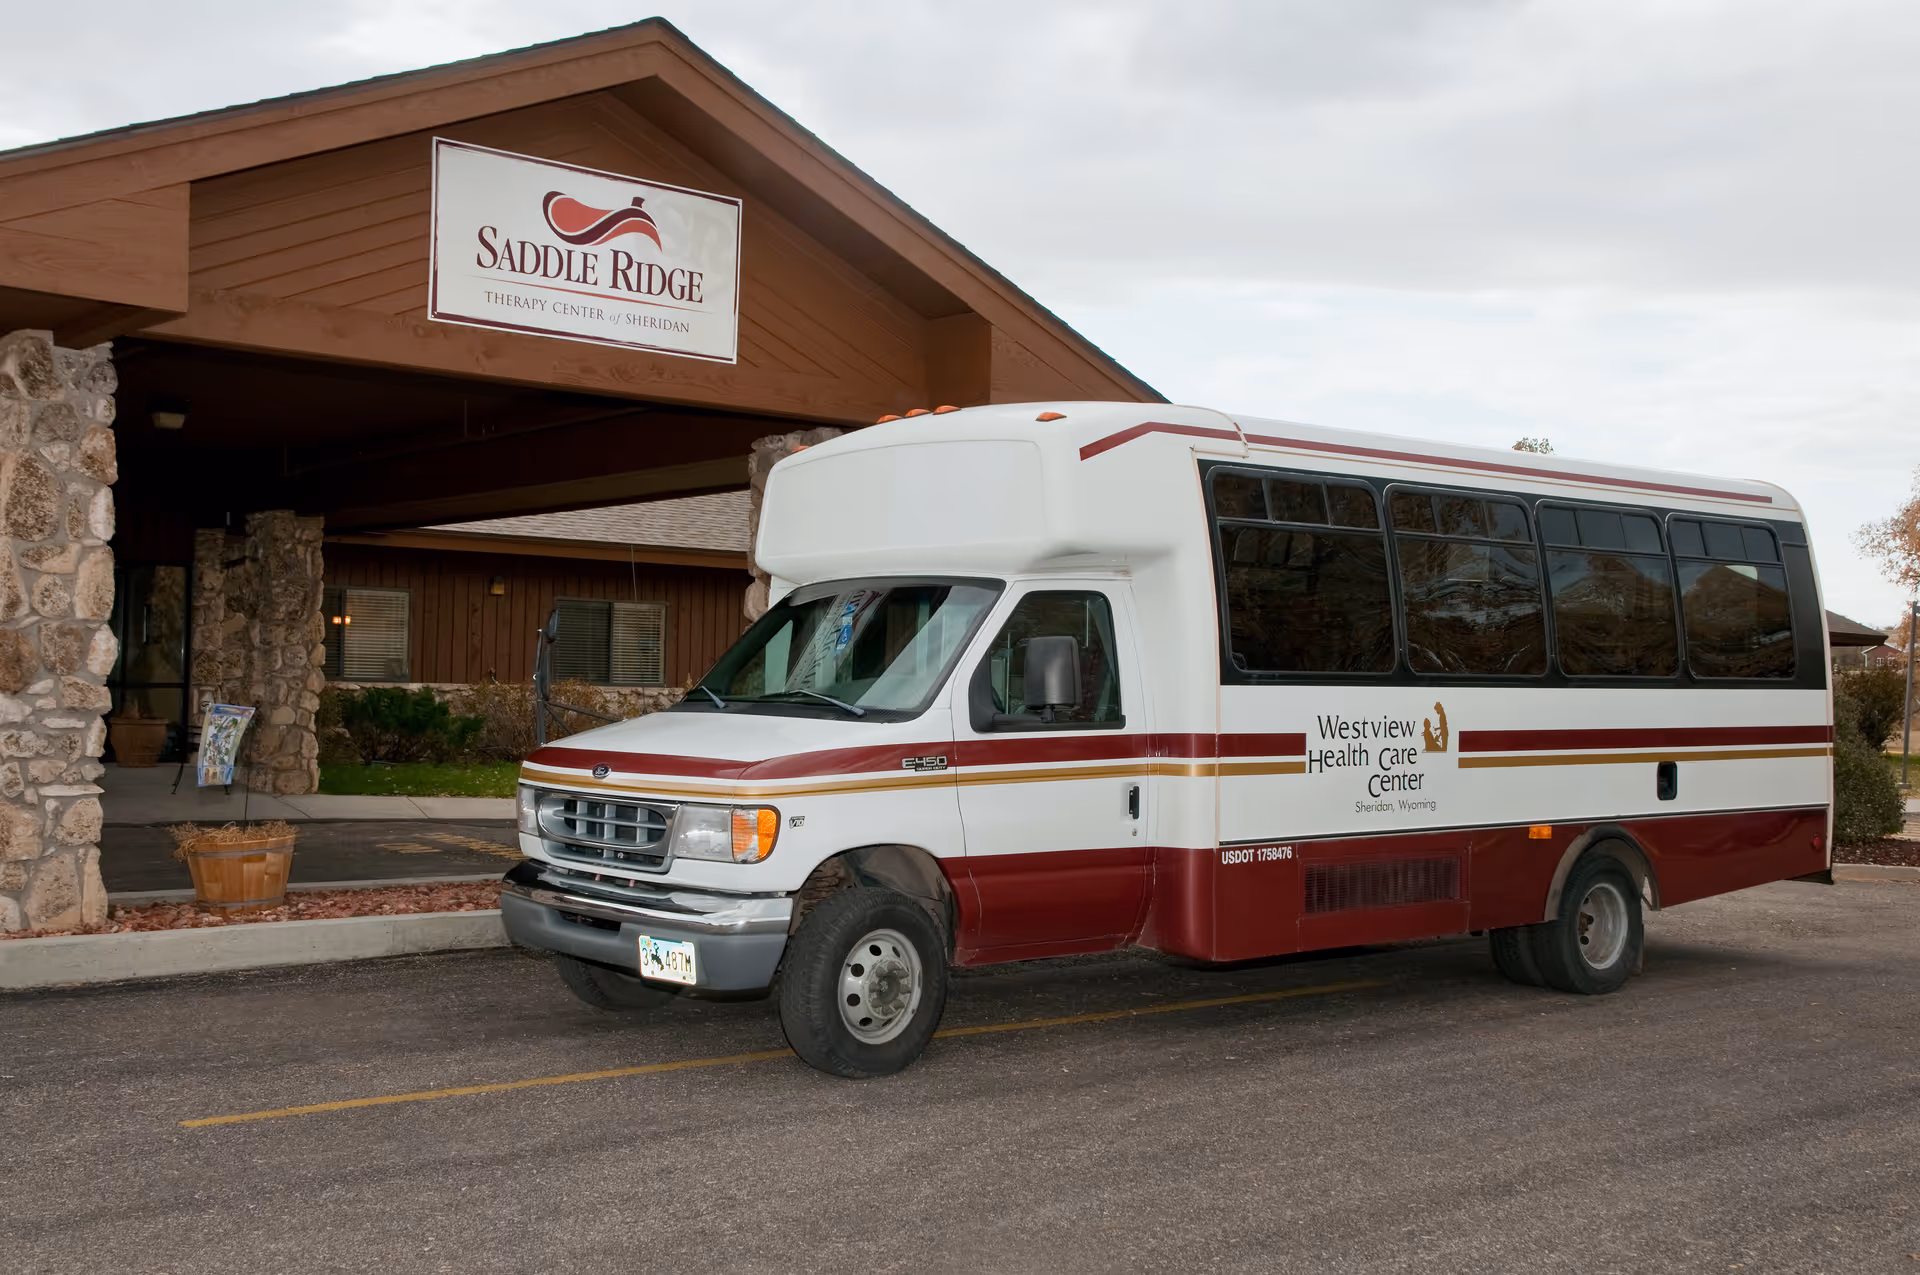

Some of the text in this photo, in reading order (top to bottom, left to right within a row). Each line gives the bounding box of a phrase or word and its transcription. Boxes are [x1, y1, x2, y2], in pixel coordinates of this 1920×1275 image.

[476, 225, 703, 304] SADDLE RIDGE
[484, 290, 690, 334] THERAPY CENTER of SHERIDAN
[1317, 715, 1416, 740] Westview
[1308, 742, 1417, 774] Health Care
[1368, 770, 1424, 798] Center
[1355, 798, 1436, 813] Sheridan, Wyoming
[1221, 846, 1292, 865] USDOT 1758476
